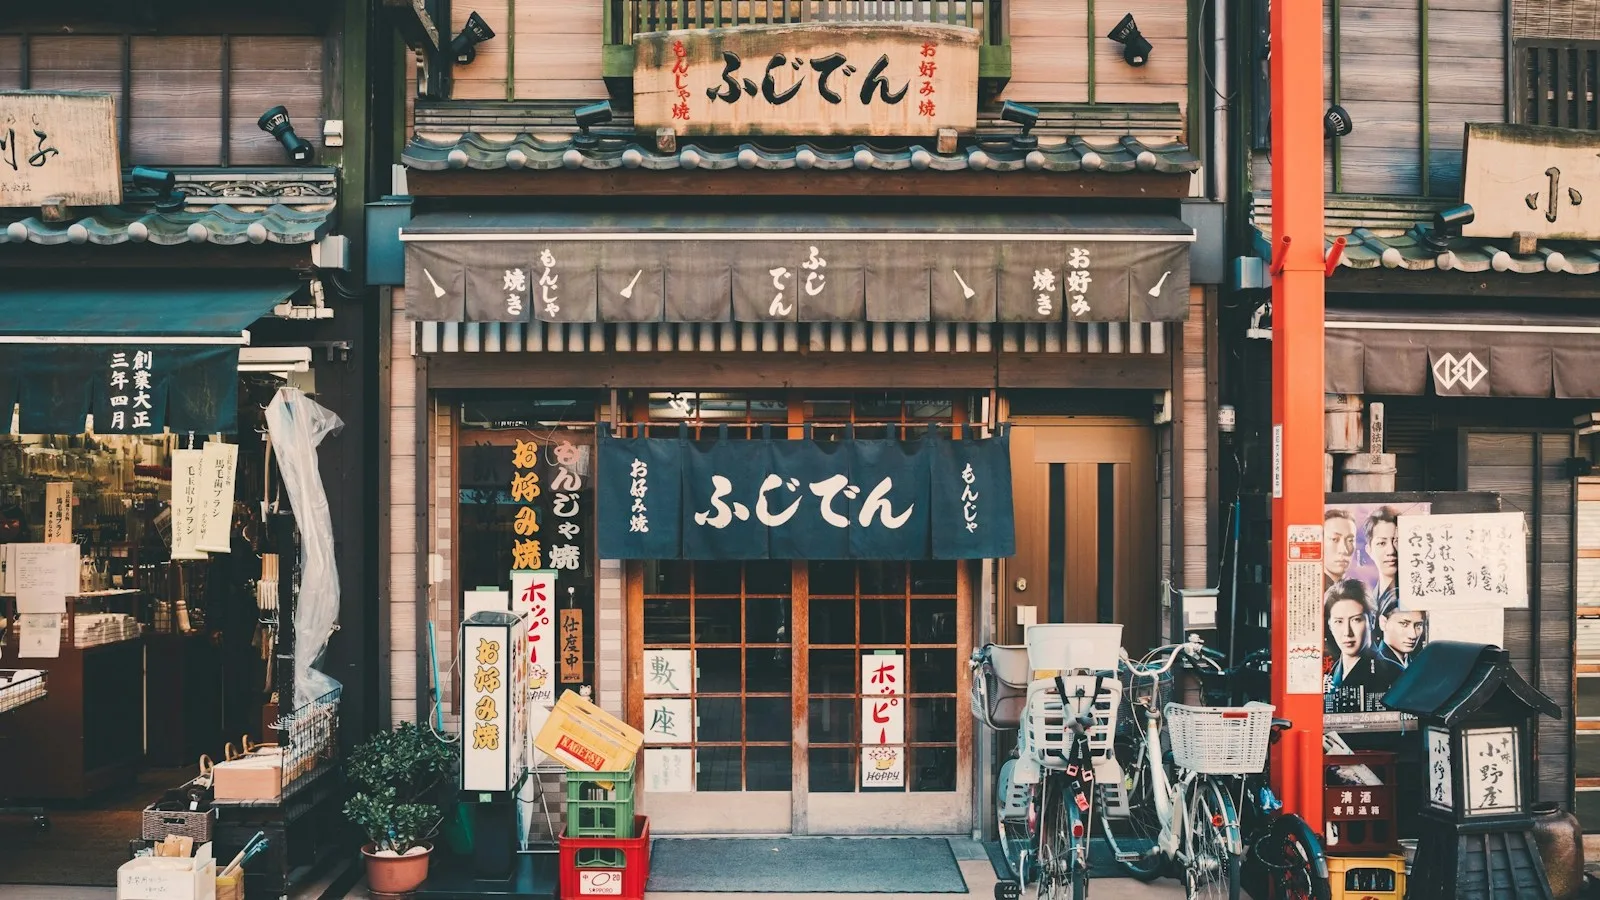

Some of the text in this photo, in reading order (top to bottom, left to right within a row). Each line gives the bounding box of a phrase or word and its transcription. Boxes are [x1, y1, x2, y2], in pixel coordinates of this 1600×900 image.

[671, 39, 691, 121] もんじゃ焼
[706, 50, 911, 106] ふじでん
[918, 41, 938, 118] お好み焼
[502, 268, 526, 316] 焼き
[538, 248, 561, 318] もんじゃ
[1032, 268, 1057, 316] 焼き
[1066, 247, 1093, 316] お好み
[109, 352, 130, 430] 三年四月
[132, 349, 154, 429] 創業大正
[511, 438, 542, 571] お好み焼
[549, 440, 582, 571] もんじゃ焼
[629, 458, 650, 533] お好み焼
[694, 473, 915, 529] ふじでん
[961, 462, 979, 534] もんじゃ
[521, 577, 550, 664] ホッピー
[563, 615, 581, 671] 仕度中
[473, 637, 501, 751] お好み焼
[871, 660, 899, 745] ホッピー
[1479, 741, 1504, 808] 小野屋
